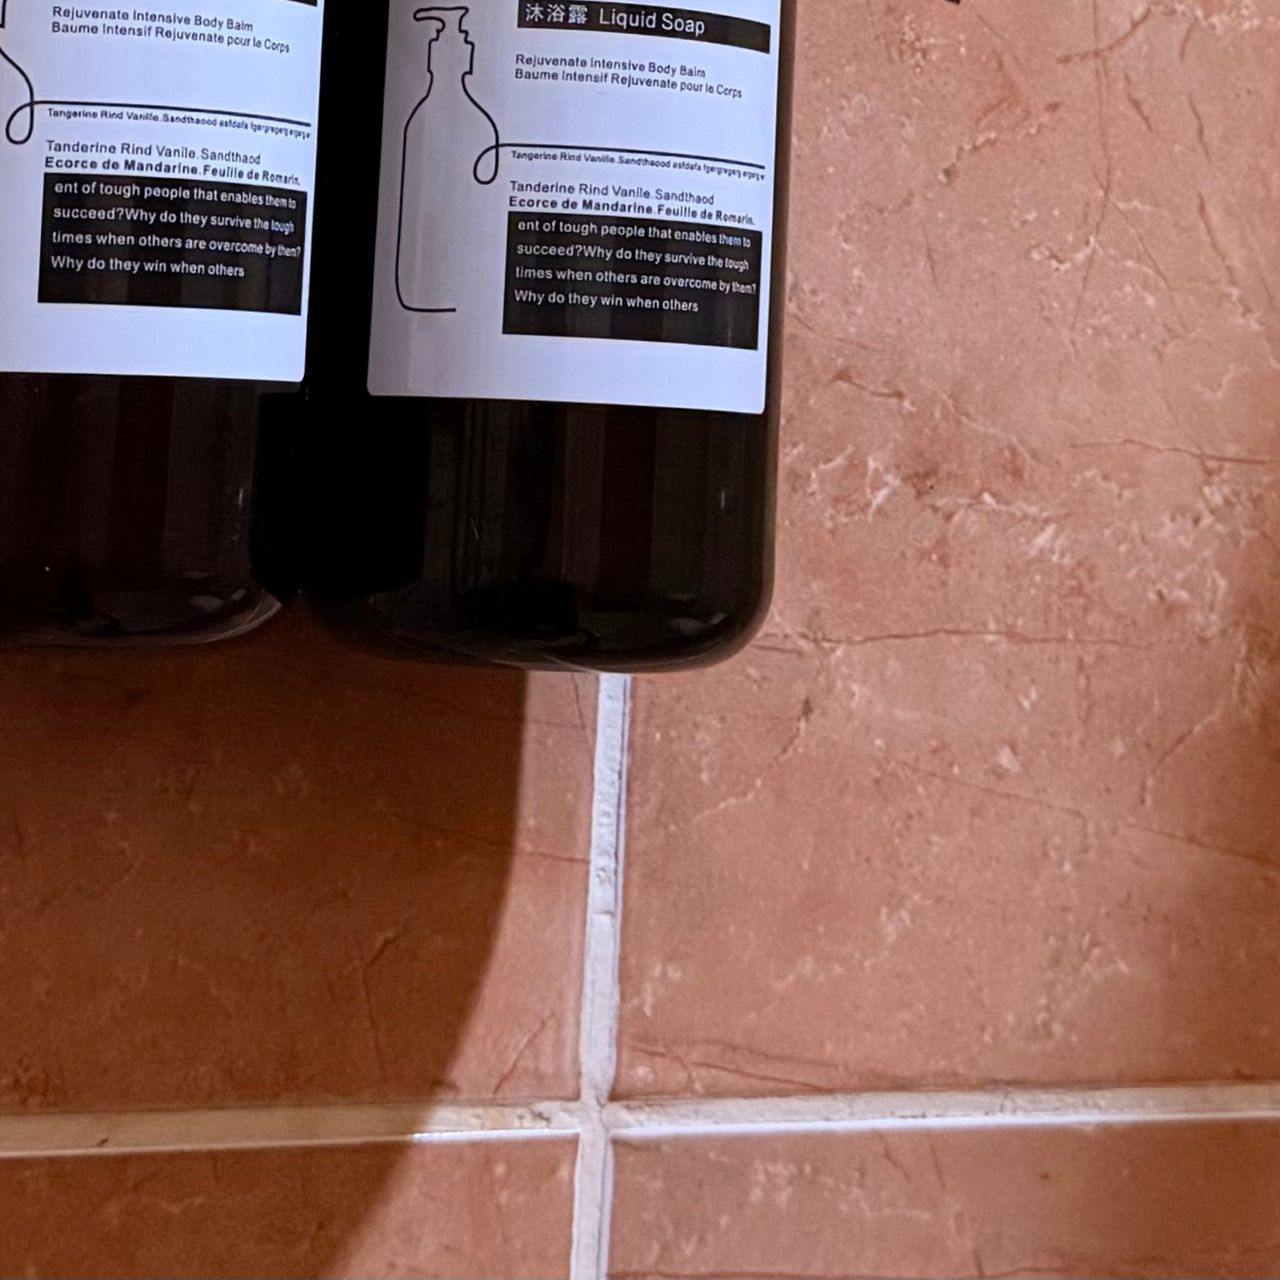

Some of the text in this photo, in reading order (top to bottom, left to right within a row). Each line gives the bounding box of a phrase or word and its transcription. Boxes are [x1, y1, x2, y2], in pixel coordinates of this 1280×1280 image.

[52, 6, 253, 32] Rejuvenate Intensive Body Balm
[525, 3, 705, 37] 沐浴露 Liquid Soap
[51, 21, 290, 54] Baume Intensif Rejuvenate pour le Corps
[515, 54, 587, 68] Rejuvenate
[590, 57, 645, 72] Intensive
[648, 62, 677, 77] Body
[515, 68, 742, 99] Baume Intensif Rejuvenate pour le Corps
[46, 140, 116, 154] Tanderine
[121, 142, 152, 156] Rind
[45, 156, 97, 169] Ecorce
[102, 159, 119, 170] de
[247, 169, 259, 180] de
[55, 181, 296, 209] ent of tough people that enables them to
[510, 180, 575, 194] Tanderine
[579, 183, 608, 196] Rind
[509, 196, 557, 208] Ecorce
[562, 198, 578, 210] de
[700, 209, 713, 220] de
[160, 210, 177, 222] do
[180, 211, 208, 228] they
[210, 215, 251, 229] survive
[254, 218, 269, 230] the
[271, 220, 294, 235] tough
[518, 220, 751, 248] ent of tough people that enables them to
[52, 230, 92, 244] times
[96, 232, 135, 245] when
[139, 234, 182, 248] others
[185, 238, 206, 249] are
[209, 240, 263, 254] overcome
[265, 243, 276, 258] by
[51, 256, 245, 277] Why do they win when others
[615, 247, 632, 259] do
[635, 248, 662, 264] they
[664, 252, 705, 265] survive
[707, 255, 723, 267] the
[725, 257, 749, 273] tough
[515, 265, 552, 279] times
[556, 268, 592, 280] when
[595, 270, 637, 284] others
[640, 274, 661, 285] are
[663, 276, 717, 290] overcome
[719, 279, 731, 294] by
[514, 289, 699, 312] Why do they win when others
